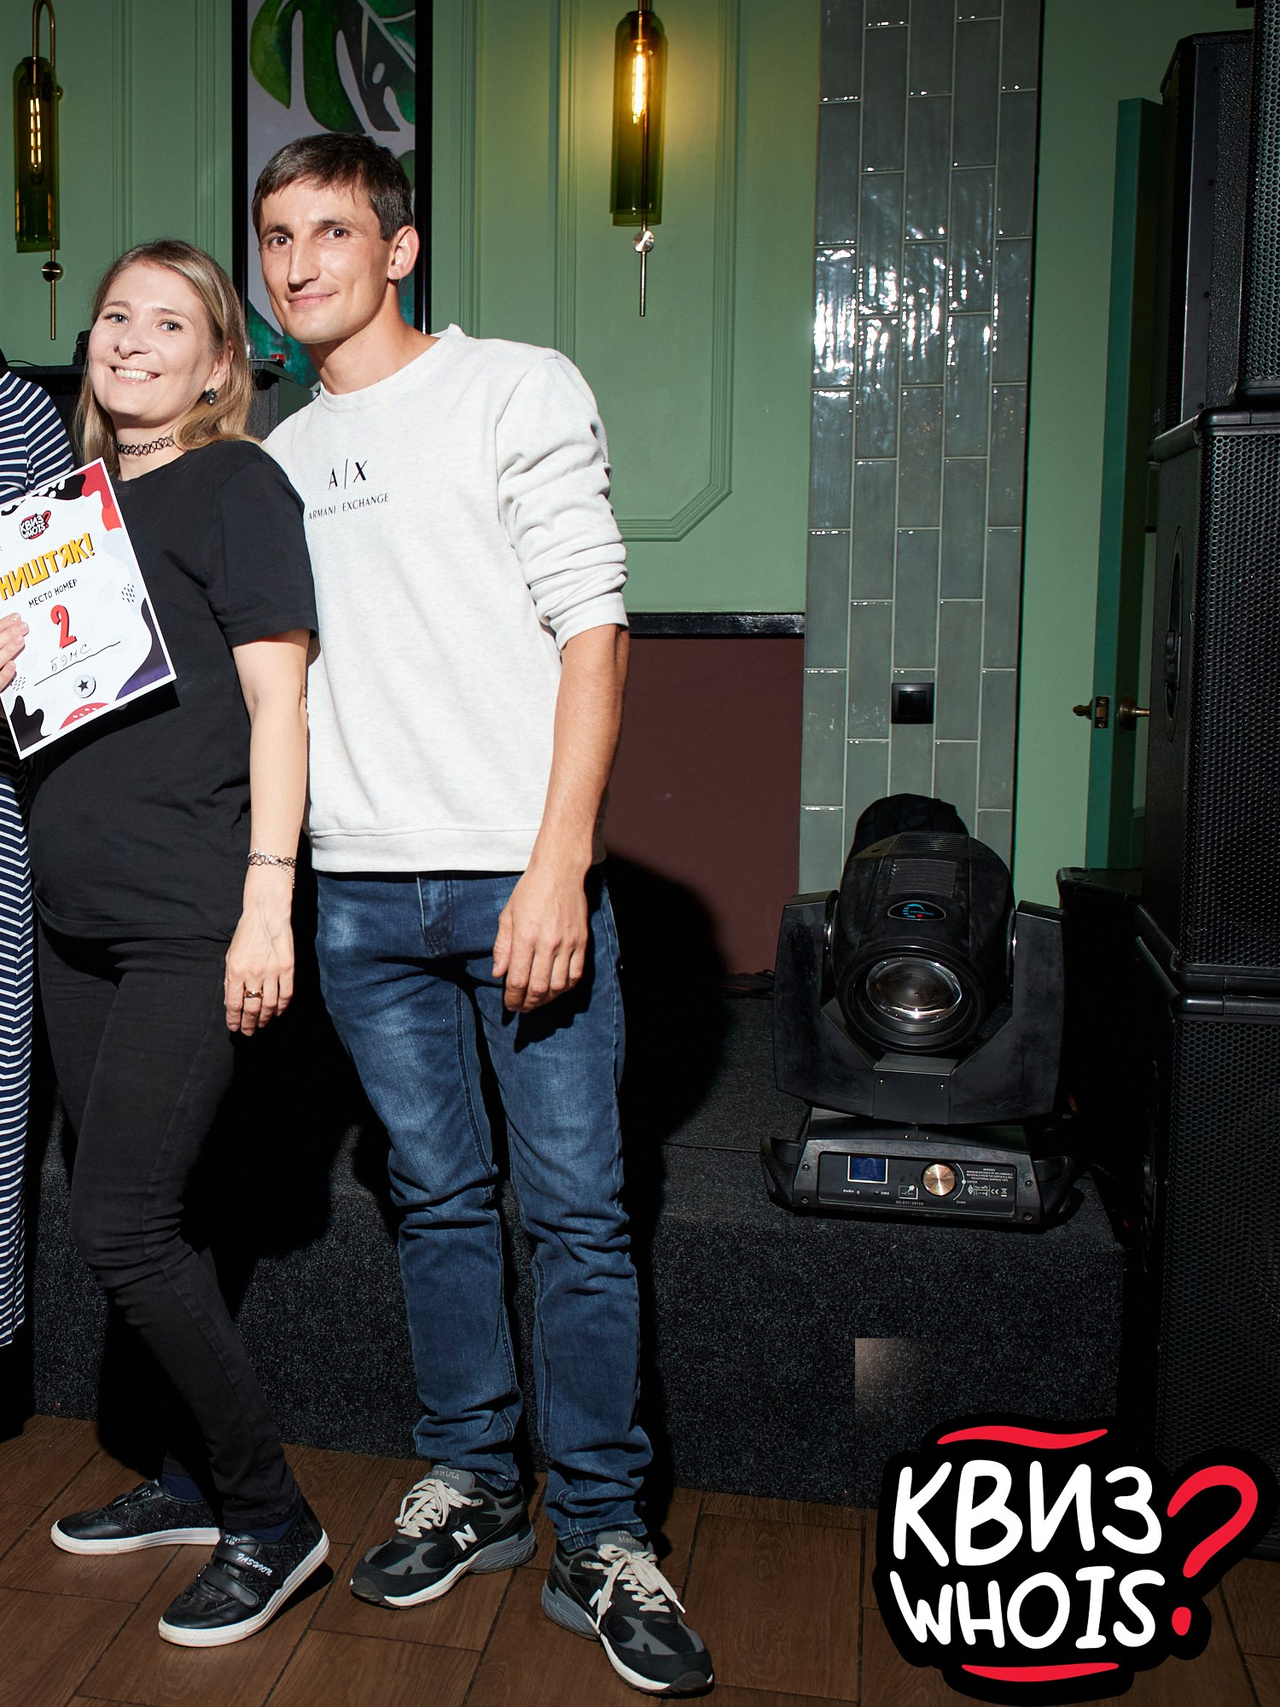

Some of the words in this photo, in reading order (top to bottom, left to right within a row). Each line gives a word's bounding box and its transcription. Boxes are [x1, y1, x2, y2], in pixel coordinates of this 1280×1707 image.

[307, 505, 337, 521] ARMANI
[342, 493, 389, 512] EXCHANGE
[28, 590, 53, 608] МЕСТО
[54, 578, 78, 597] НОМЕР
[50, 604, 77, 649] 2
[445, 1471, 460, 1481] USA
